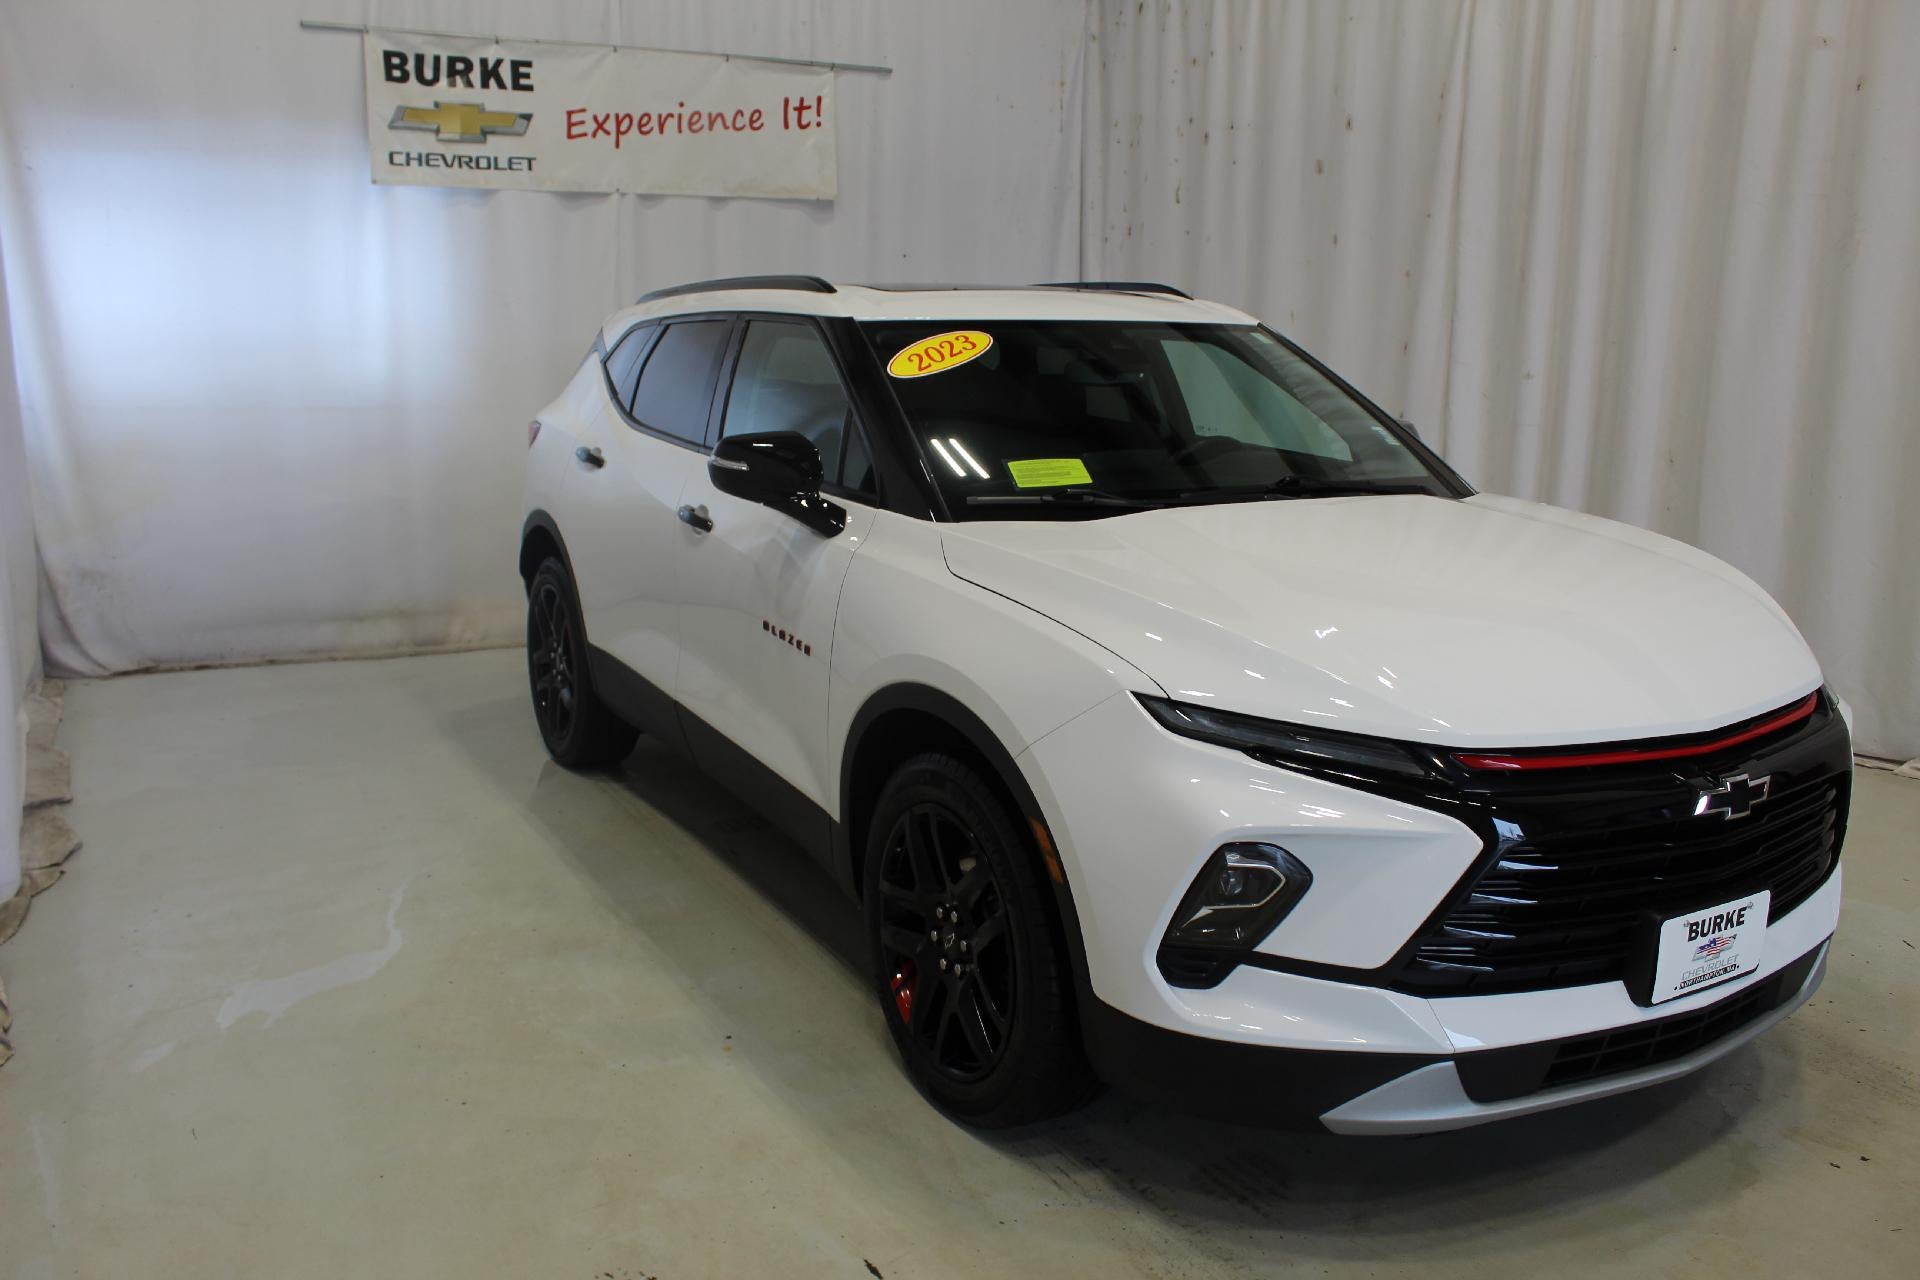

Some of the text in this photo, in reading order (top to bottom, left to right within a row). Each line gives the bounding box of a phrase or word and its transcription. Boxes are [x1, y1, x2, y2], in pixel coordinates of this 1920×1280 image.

[383, 49, 535, 92] BURKE
[566, 96, 823, 148] Experience It!
[389, 151, 537, 172] CHEVROLET
[908, 335, 976, 371] 2023
[763, 620, 811, 657] BLAZER
[1688, 907, 1747, 942] BURKE
[1682, 954, 1739, 980] CHEVROLET
